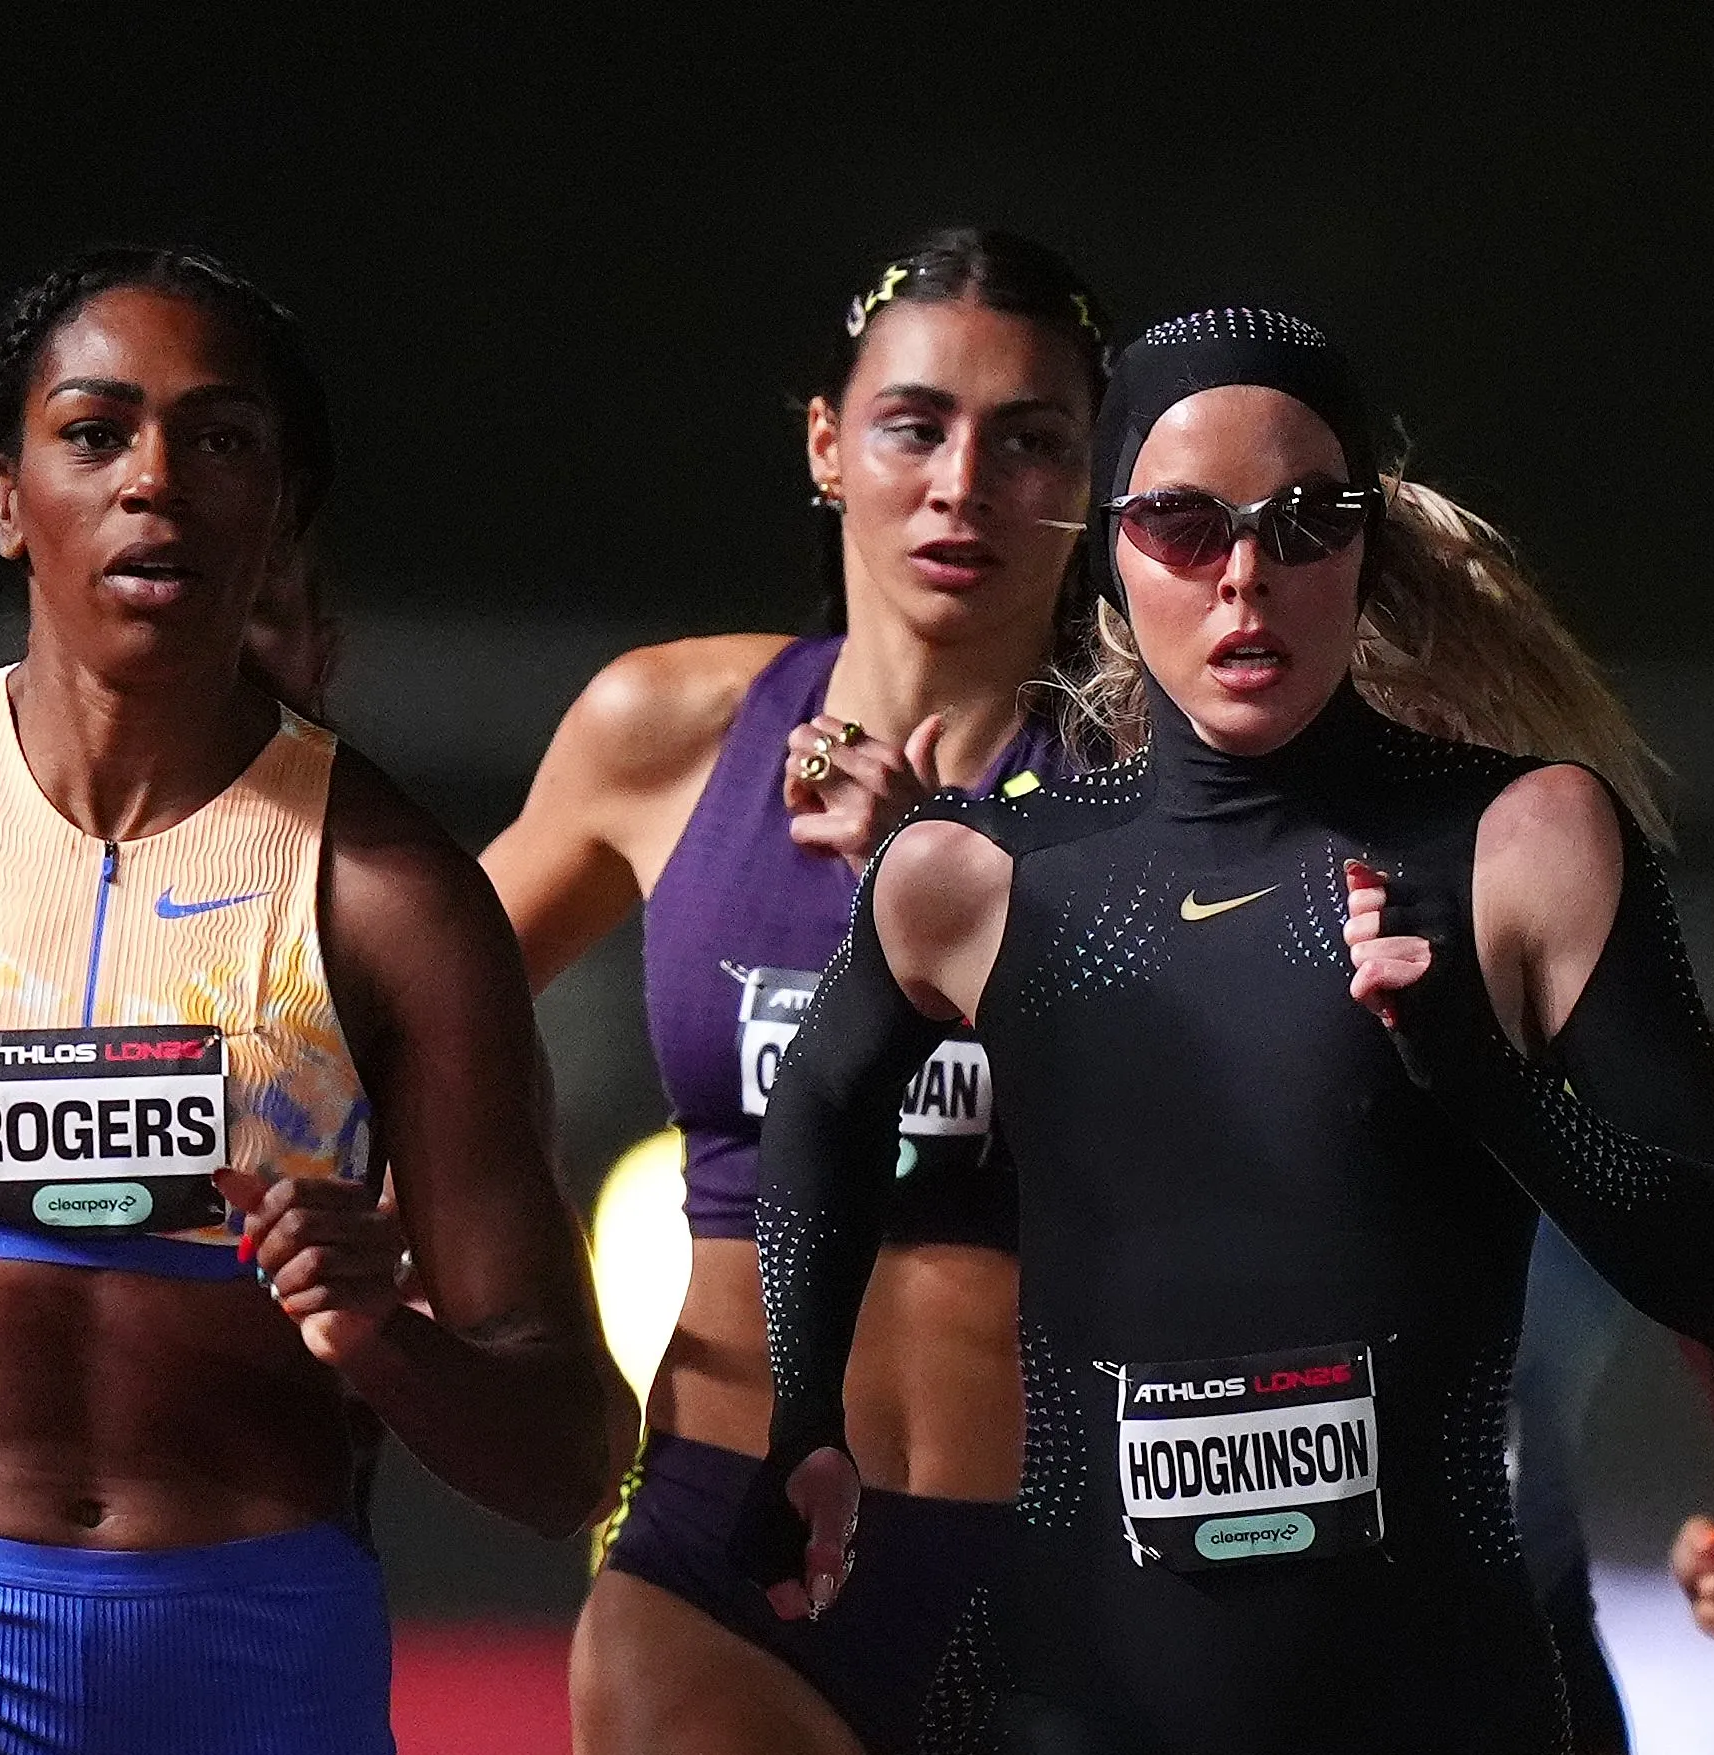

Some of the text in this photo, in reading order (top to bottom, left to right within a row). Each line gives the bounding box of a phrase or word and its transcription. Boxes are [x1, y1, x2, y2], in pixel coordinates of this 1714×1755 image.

[48, 1197, 118, 1213] clearpay
[1133, 1376, 1246, 1403] ATHLOS
[1127, 1418, 1369, 1501] HODGKINSON
[1210, 1528, 1281, 1545] clearpay
